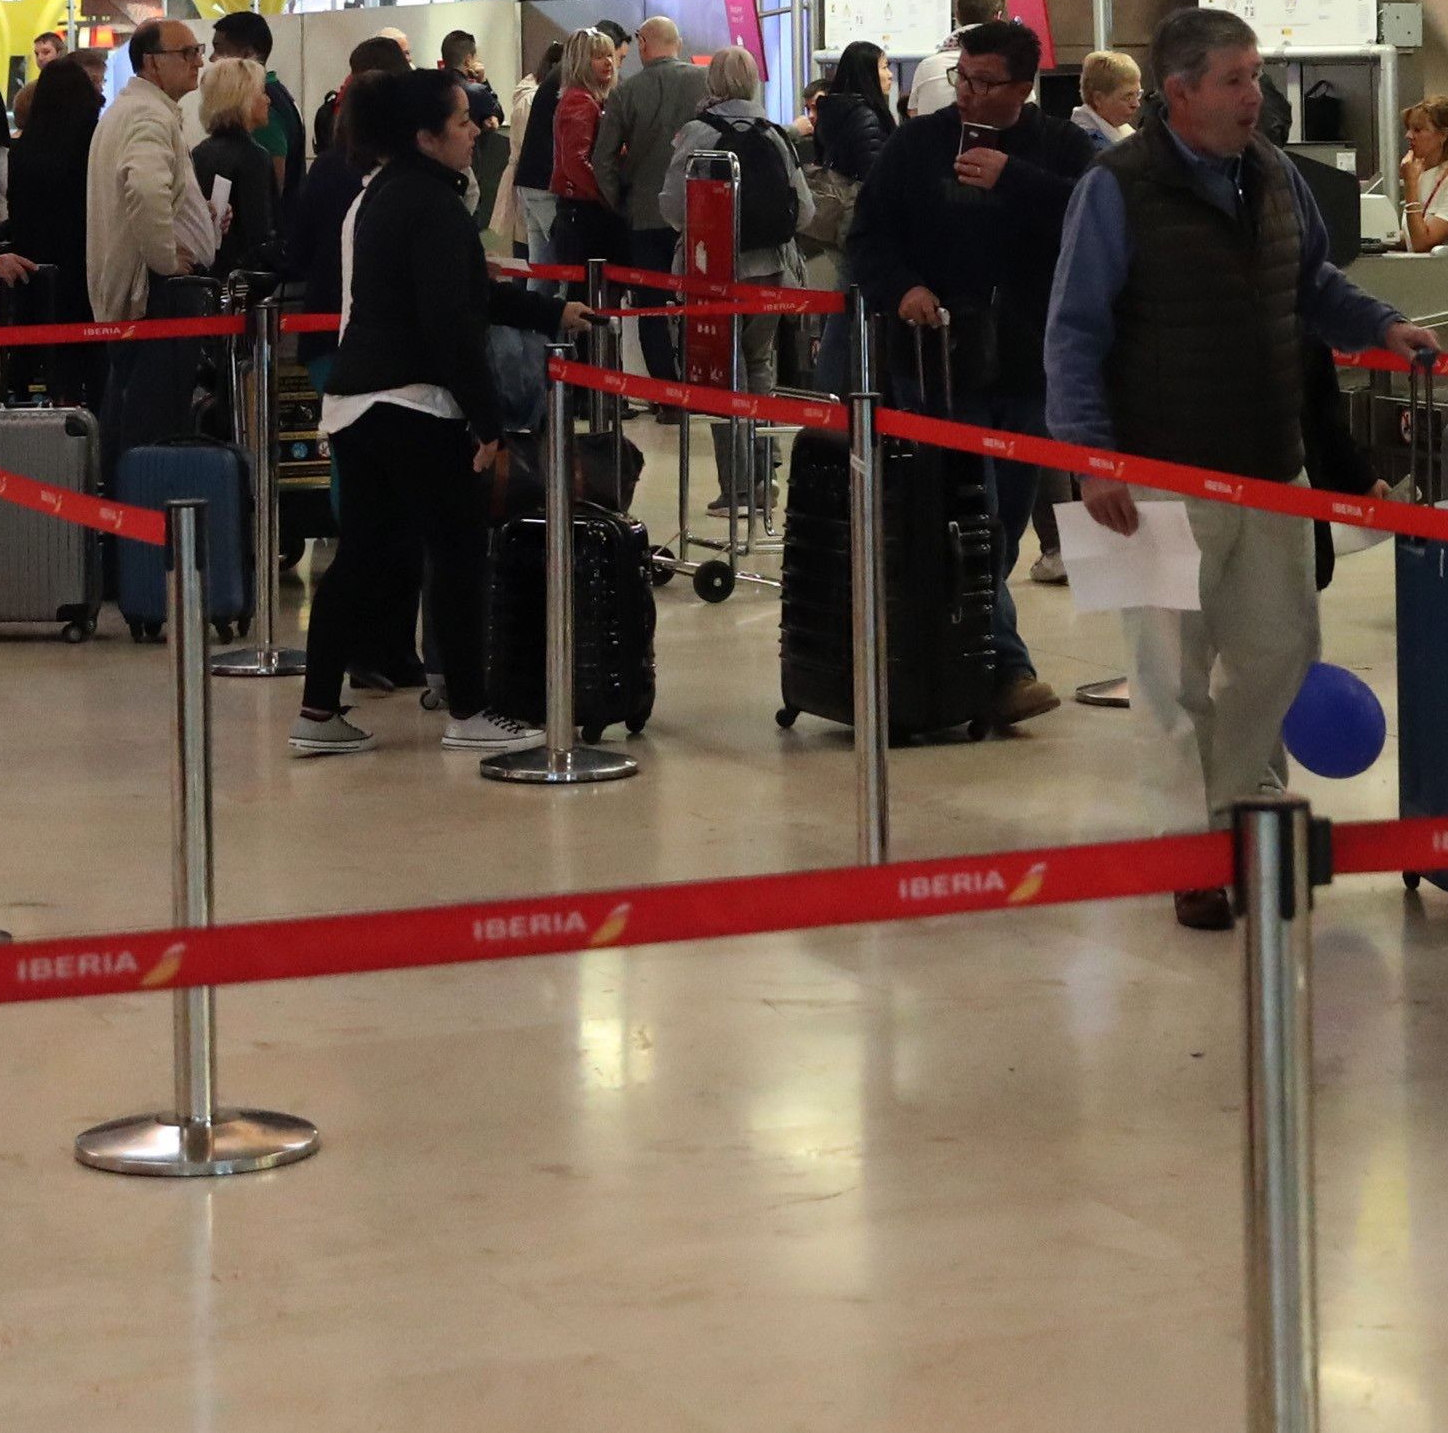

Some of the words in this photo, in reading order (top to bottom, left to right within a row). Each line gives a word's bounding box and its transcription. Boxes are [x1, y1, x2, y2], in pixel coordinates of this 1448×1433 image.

[762, 302, 796, 312] IBERIA
[83, 327, 121, 336] IBERIA
[1088, 456, 1115, 471] IBERIA
[1204, 478, 1232, 494] IBERIA
[1332, 502, 1363, 518] IBERIA
[898, 869, 1005, 899] IBERIA
[472, 911, 588, 943] IBERIA
[16, 949, 139, 983] IBERIA
